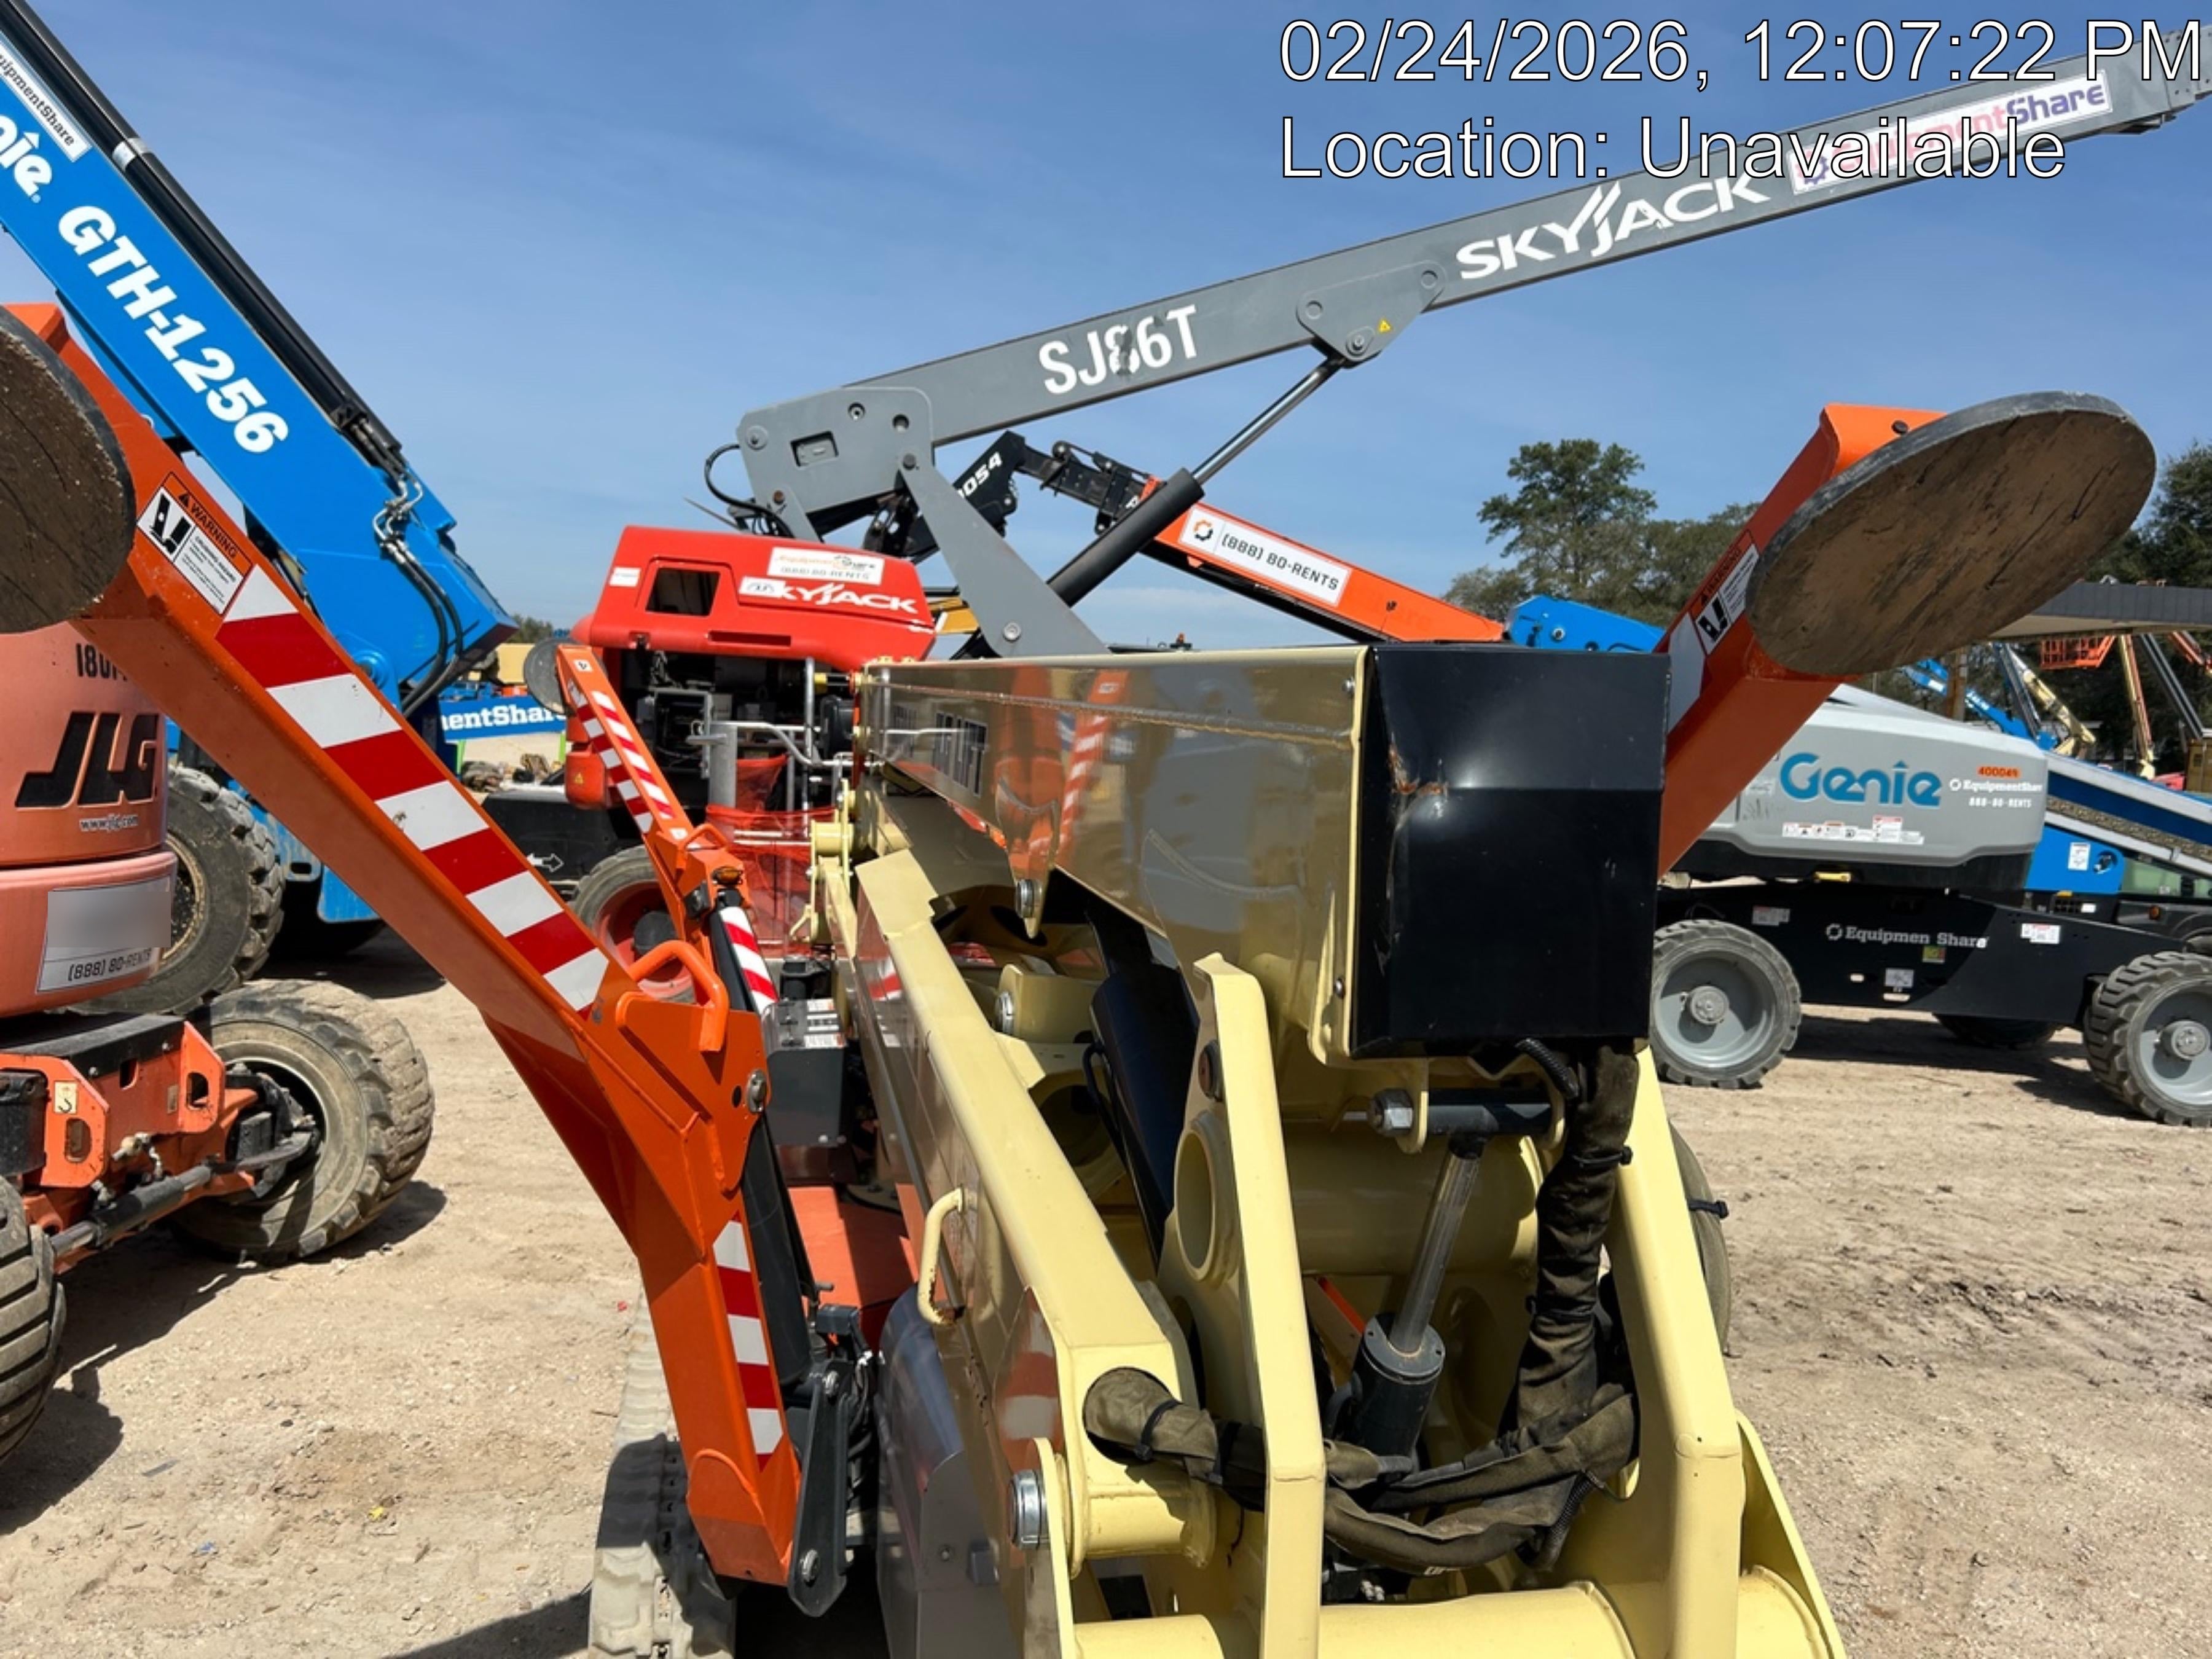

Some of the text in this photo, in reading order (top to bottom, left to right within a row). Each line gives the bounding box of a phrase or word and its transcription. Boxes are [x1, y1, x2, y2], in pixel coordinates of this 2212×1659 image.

[1456, 170, 1772, 280] SKYJACK
[58, 206, 289, 453] GTH-1256
[1038, 304, 1198, 394] SJ86T
[191, 502, 238, 558] WARNING
[1222, 533, 1339, 591] (888) 80-RENTS
[782, 582, 918, 614] KYJACK
[15, 711, 159, 809] JLG
[1780, 752, 1942, 807] Genie
[68, 959, 106, 982] (888)
